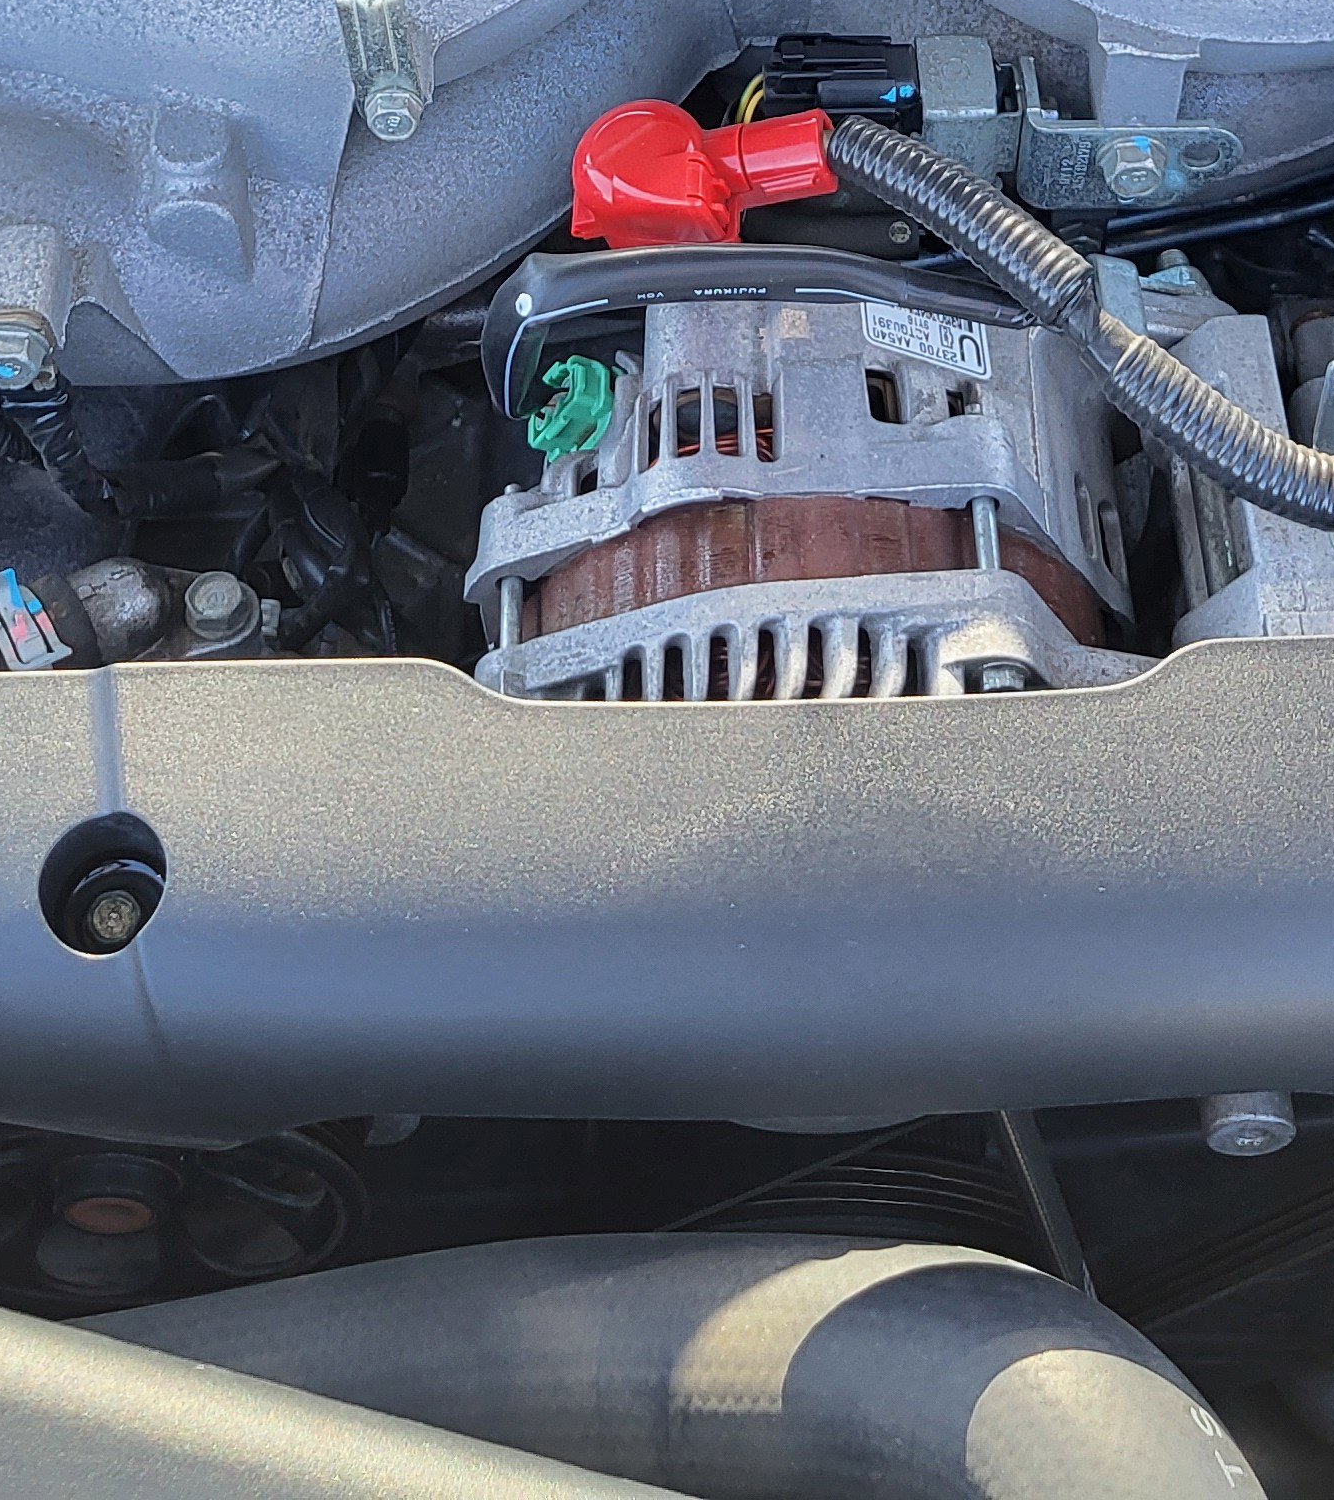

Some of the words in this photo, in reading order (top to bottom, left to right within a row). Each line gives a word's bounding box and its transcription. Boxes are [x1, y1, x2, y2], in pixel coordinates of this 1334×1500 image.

[694, 287, 766, 297] FUJIKURA
[872, 327, 910, 348] AA540
[919, 342, 958, 364] 23700
